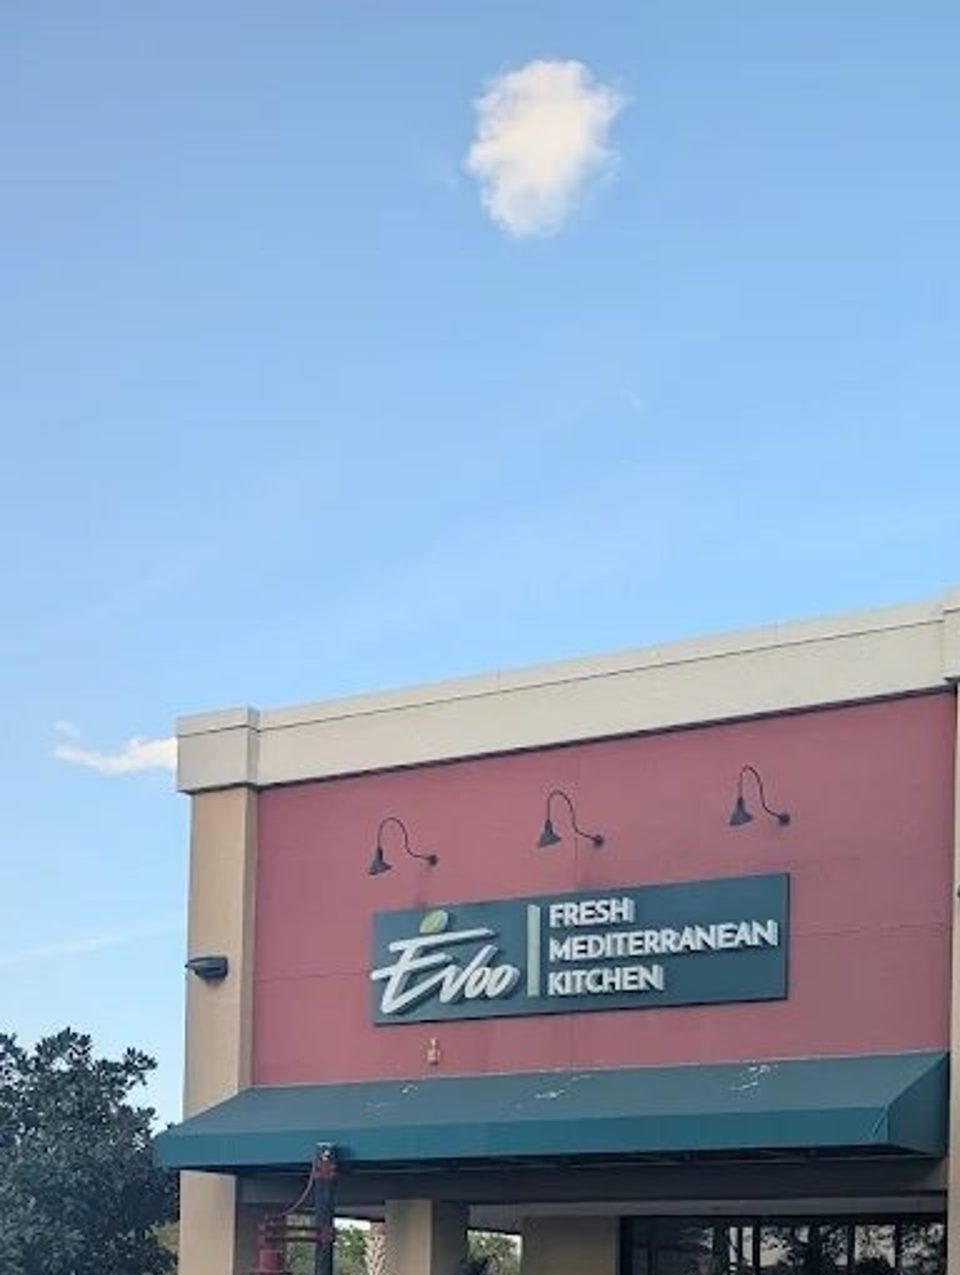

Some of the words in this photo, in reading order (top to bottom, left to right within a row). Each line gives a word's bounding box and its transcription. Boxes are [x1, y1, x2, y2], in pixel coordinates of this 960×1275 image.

[549, 897, 635, 928] FRESH
[549, 919, 779, 962] MEDITERRANEAN
[548, 965, 664, 996] KITCHEN
